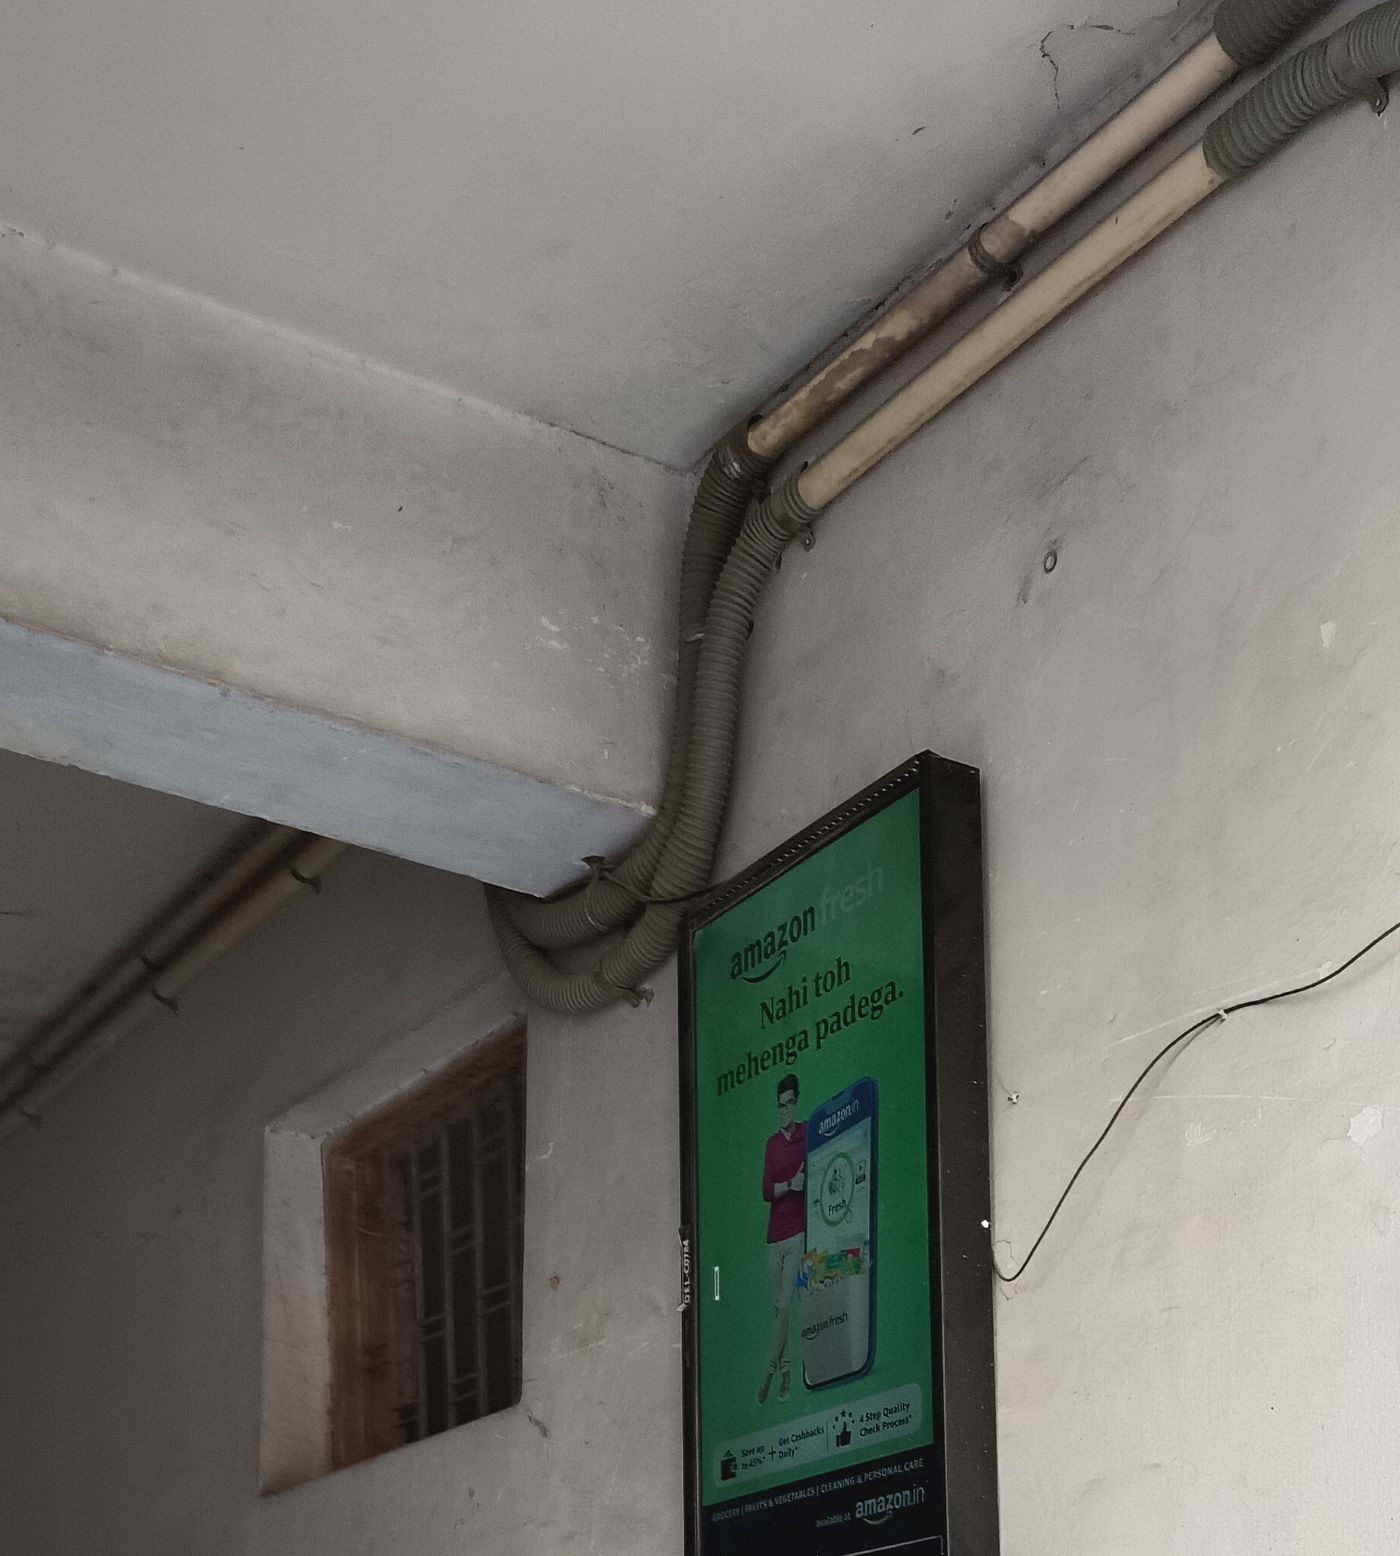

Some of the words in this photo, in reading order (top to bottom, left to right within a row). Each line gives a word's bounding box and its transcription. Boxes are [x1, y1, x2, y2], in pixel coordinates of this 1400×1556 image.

[730, 905, 816, 980] amazon
[819, 865, 884, 925] fresh
[760, 977, 808, 1030] Nahi
[814, 957, 851, 998] toh
[716, 1028, 810, 1096] mehenga
[815, 979, 904, 1050] padega.
[828, 1199, 847, 1216] Fresh
[859, 1423, 881, 1437] Check
[864, 1410, 882, 1423] Step
[883, 1401, 911, 1418] Quality
[778, 1435, 790, 1447] Get
[790, 1425, 825, 1444] Cashbacks
[745, 1501, 768, 1516] FRUITS
[774, 1487, 815, 1506] VEGETABLES
[820, 1474, 855, 1494] CLEANING
[864, 1465, 902, 1482] PERSONAL
[904, 1457, 924, 1472] CARE
[855, 1484, 926, 1520] amazon.in
